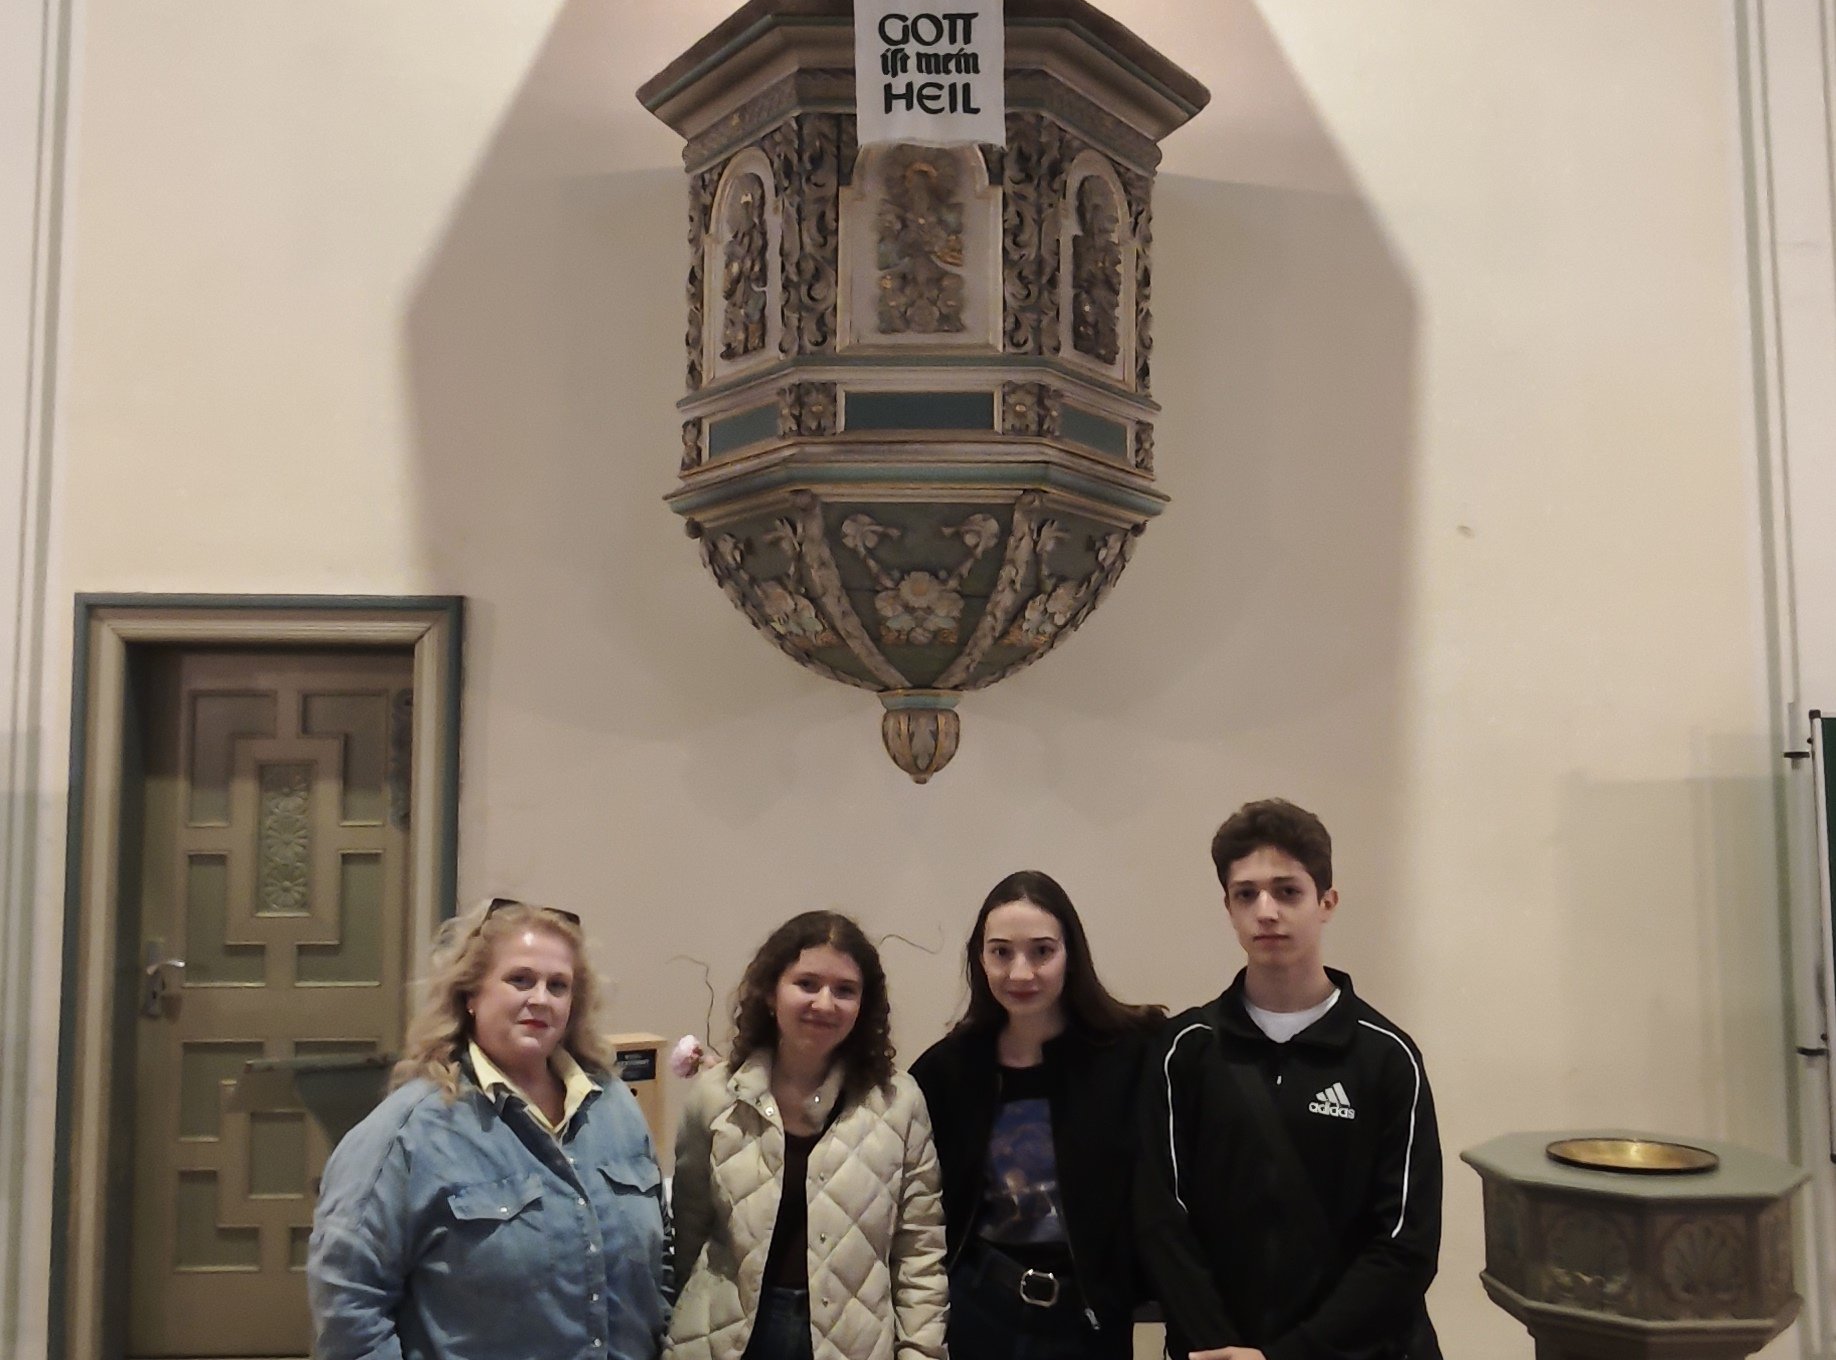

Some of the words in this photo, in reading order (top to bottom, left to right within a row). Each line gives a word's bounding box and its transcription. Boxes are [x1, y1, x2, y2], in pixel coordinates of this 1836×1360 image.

[878, 12, 979, 46] GOTT
[916, 47, 980, 75] mein
[884, 81, 981, 114] HEIL
[1309, 1101, 1355, 1119] adidas
